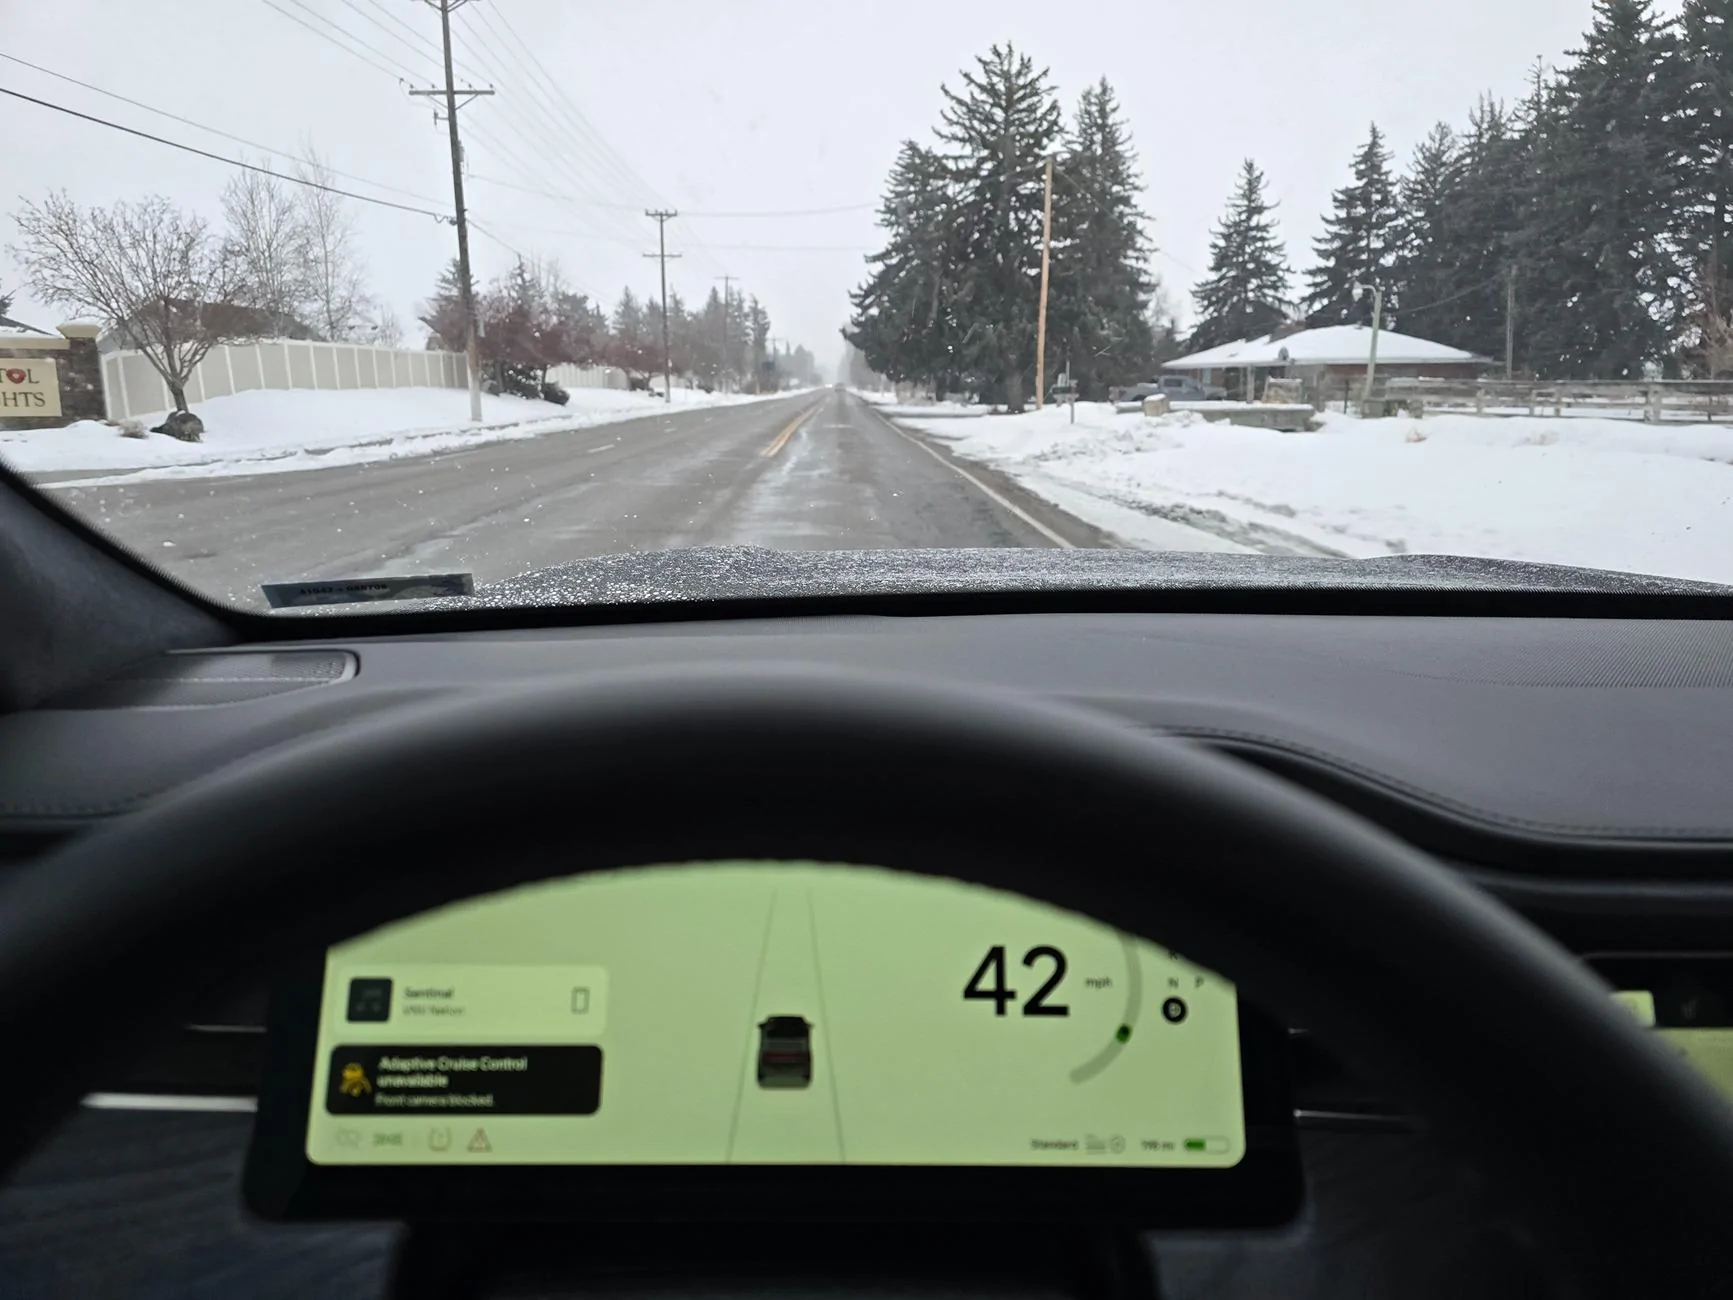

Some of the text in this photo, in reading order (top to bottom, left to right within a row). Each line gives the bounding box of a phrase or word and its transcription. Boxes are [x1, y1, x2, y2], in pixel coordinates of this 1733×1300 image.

[963, 945, 1070, 1017] 42
[1085, 977, 1113, 989] mph
[1168, 977, 1179, 989] N
[1195, 976, 1205, 989] P
[378, 1056, 528, 1072] Adaptive Cruise Control
[376, 1074, 449, 1088] unavailable
[375, 1093, 405, 1106] Front
[406, 1094, 448, 1106] camera
